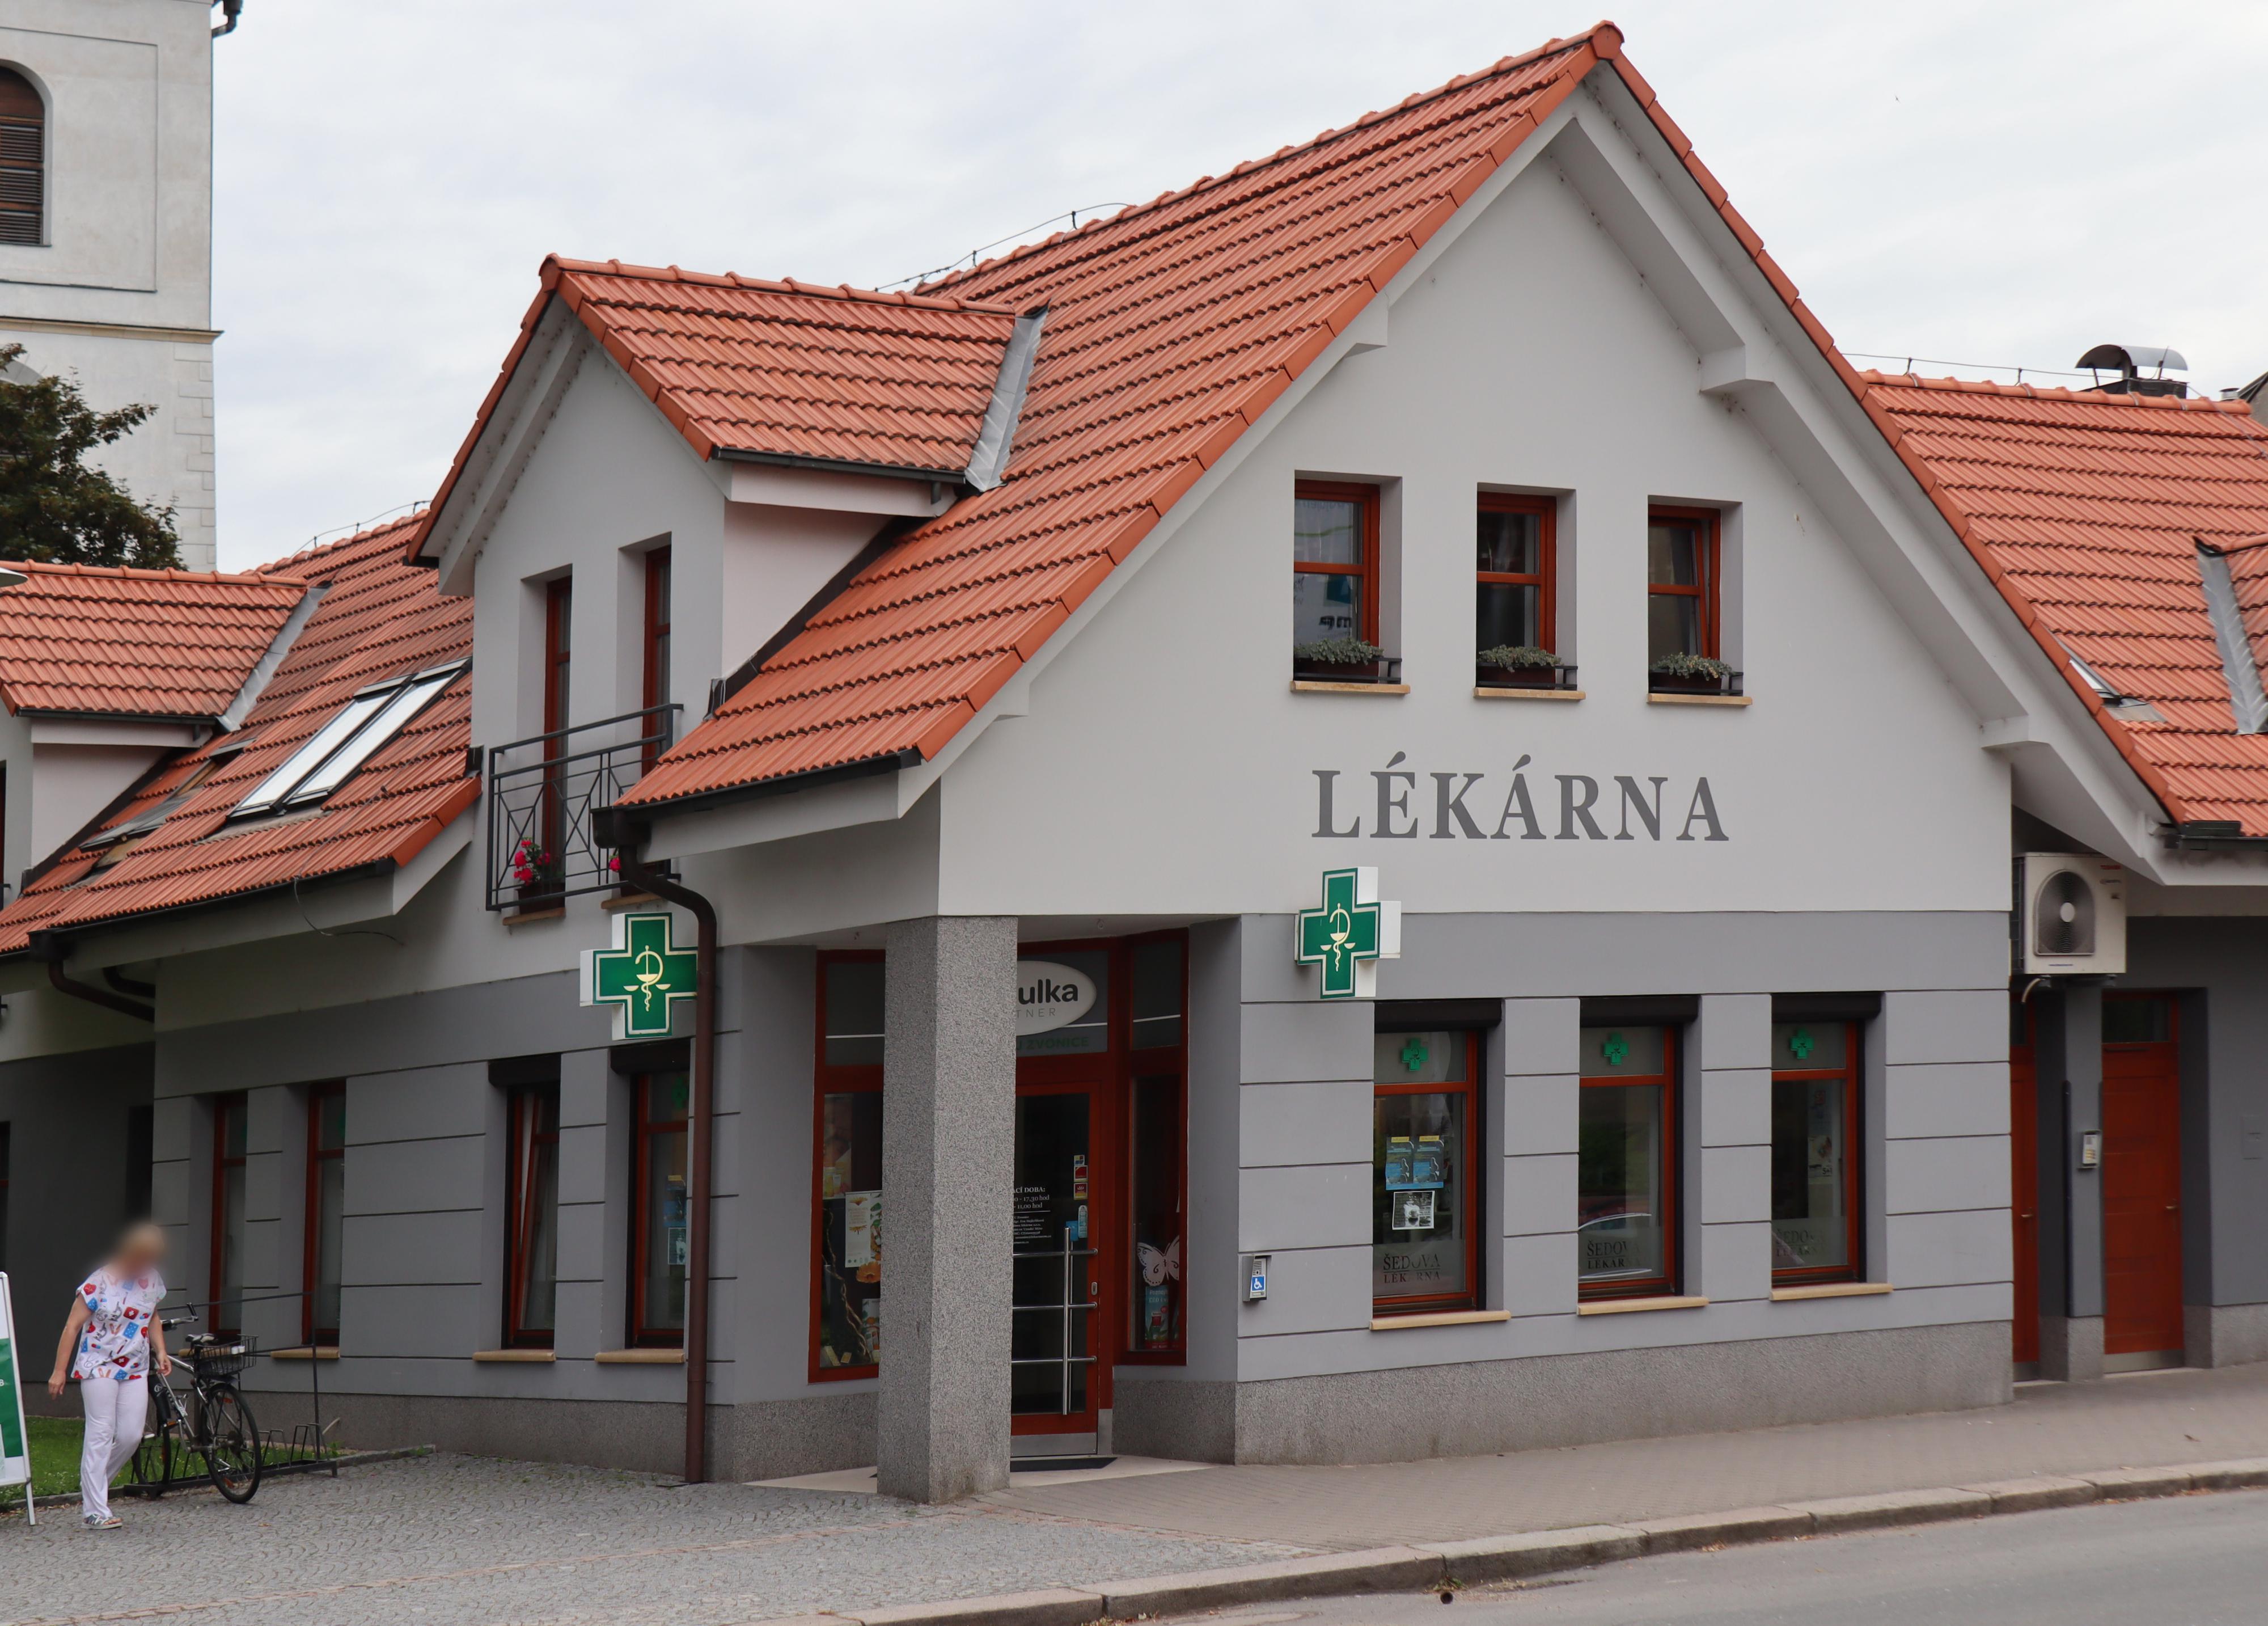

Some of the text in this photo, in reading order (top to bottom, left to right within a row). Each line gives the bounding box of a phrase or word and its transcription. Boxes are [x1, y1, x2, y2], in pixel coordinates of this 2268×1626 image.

[1311, 751, 1729, 842] LÉKÁRNA
[1026, 1036, 1089, 1050] ZVONICE
[1384, 1271, 1441, 1283] LÉKRNA
